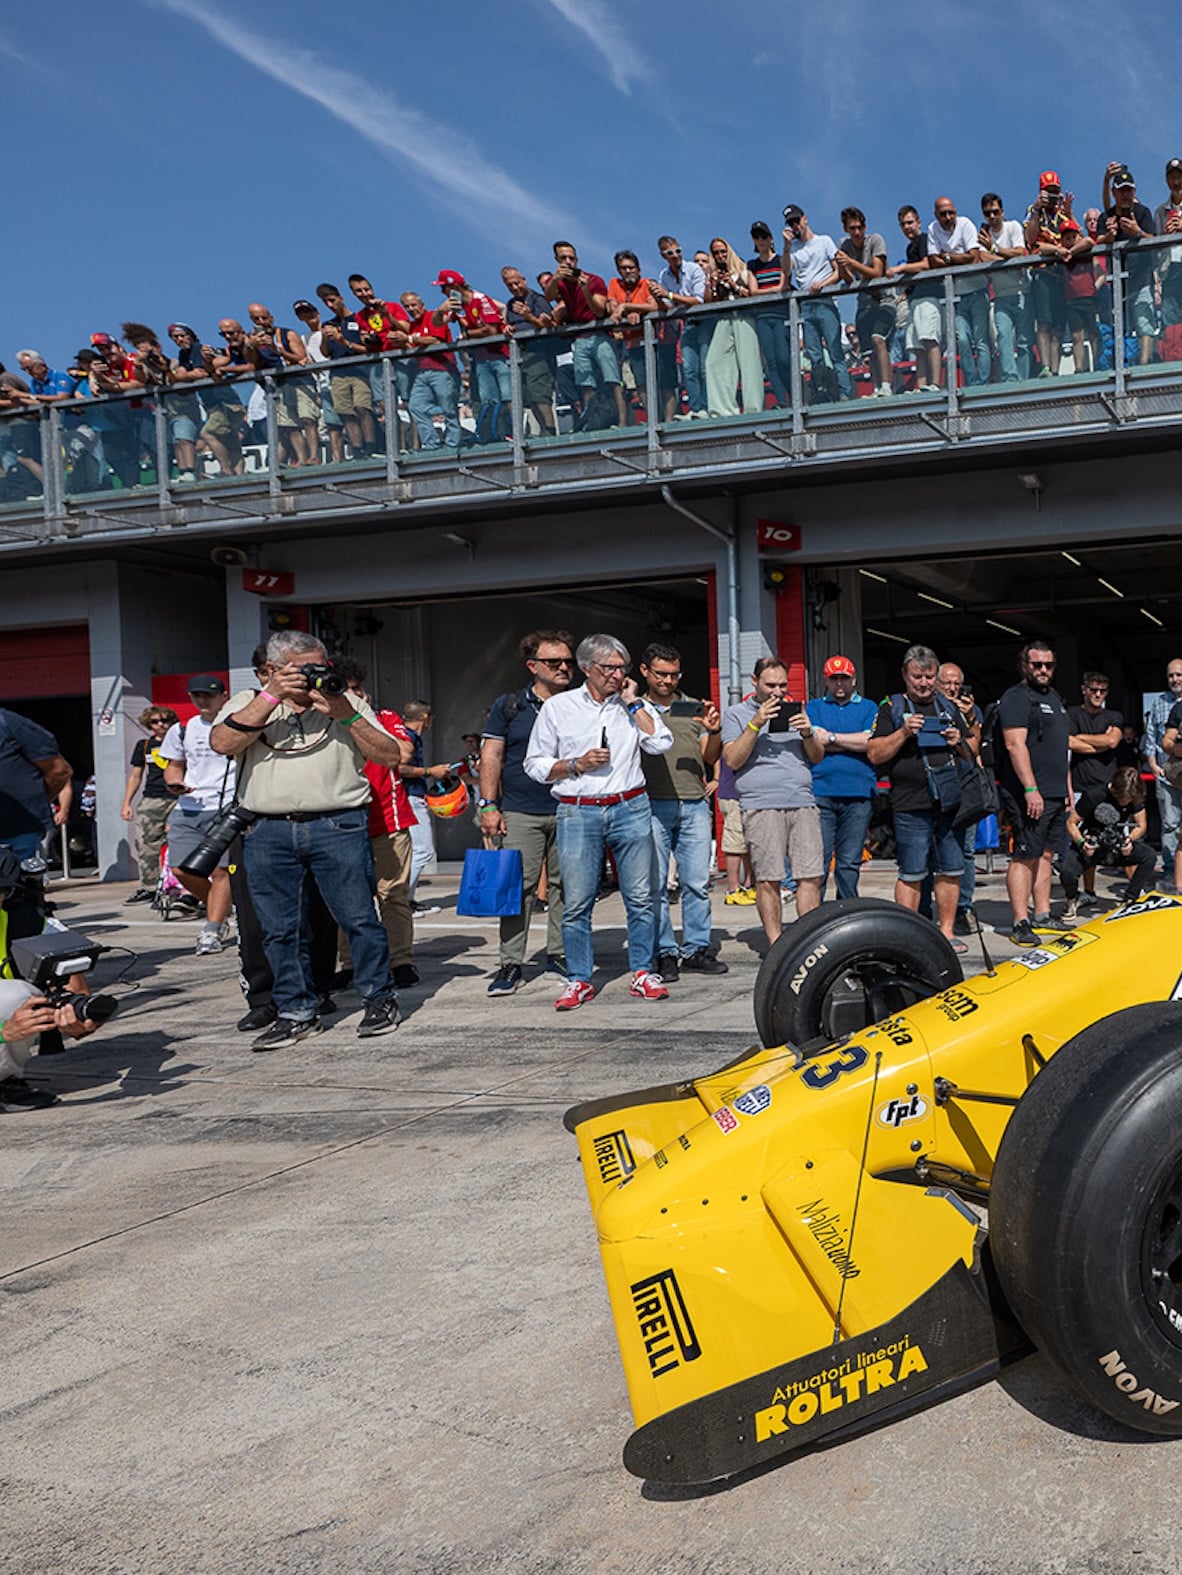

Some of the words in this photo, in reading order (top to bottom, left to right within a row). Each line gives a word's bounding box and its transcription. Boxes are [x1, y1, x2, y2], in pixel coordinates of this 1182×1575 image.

[764, 526, 793, 541] 10
[254, 575, 280, 587] 11
[790, 943, 829, 995] AVON
[593, 1129, 637, 1184] PIRELLI
[630, 1267, 702, 1379] PIRELLI
[754, 1344, 929, 1444] ROLTRA
[771, 1358, 851, 1405] Attuatori
[857, 1334, 911, 1369] lineari
[1098, 1349, 1181, 1416] AVON
